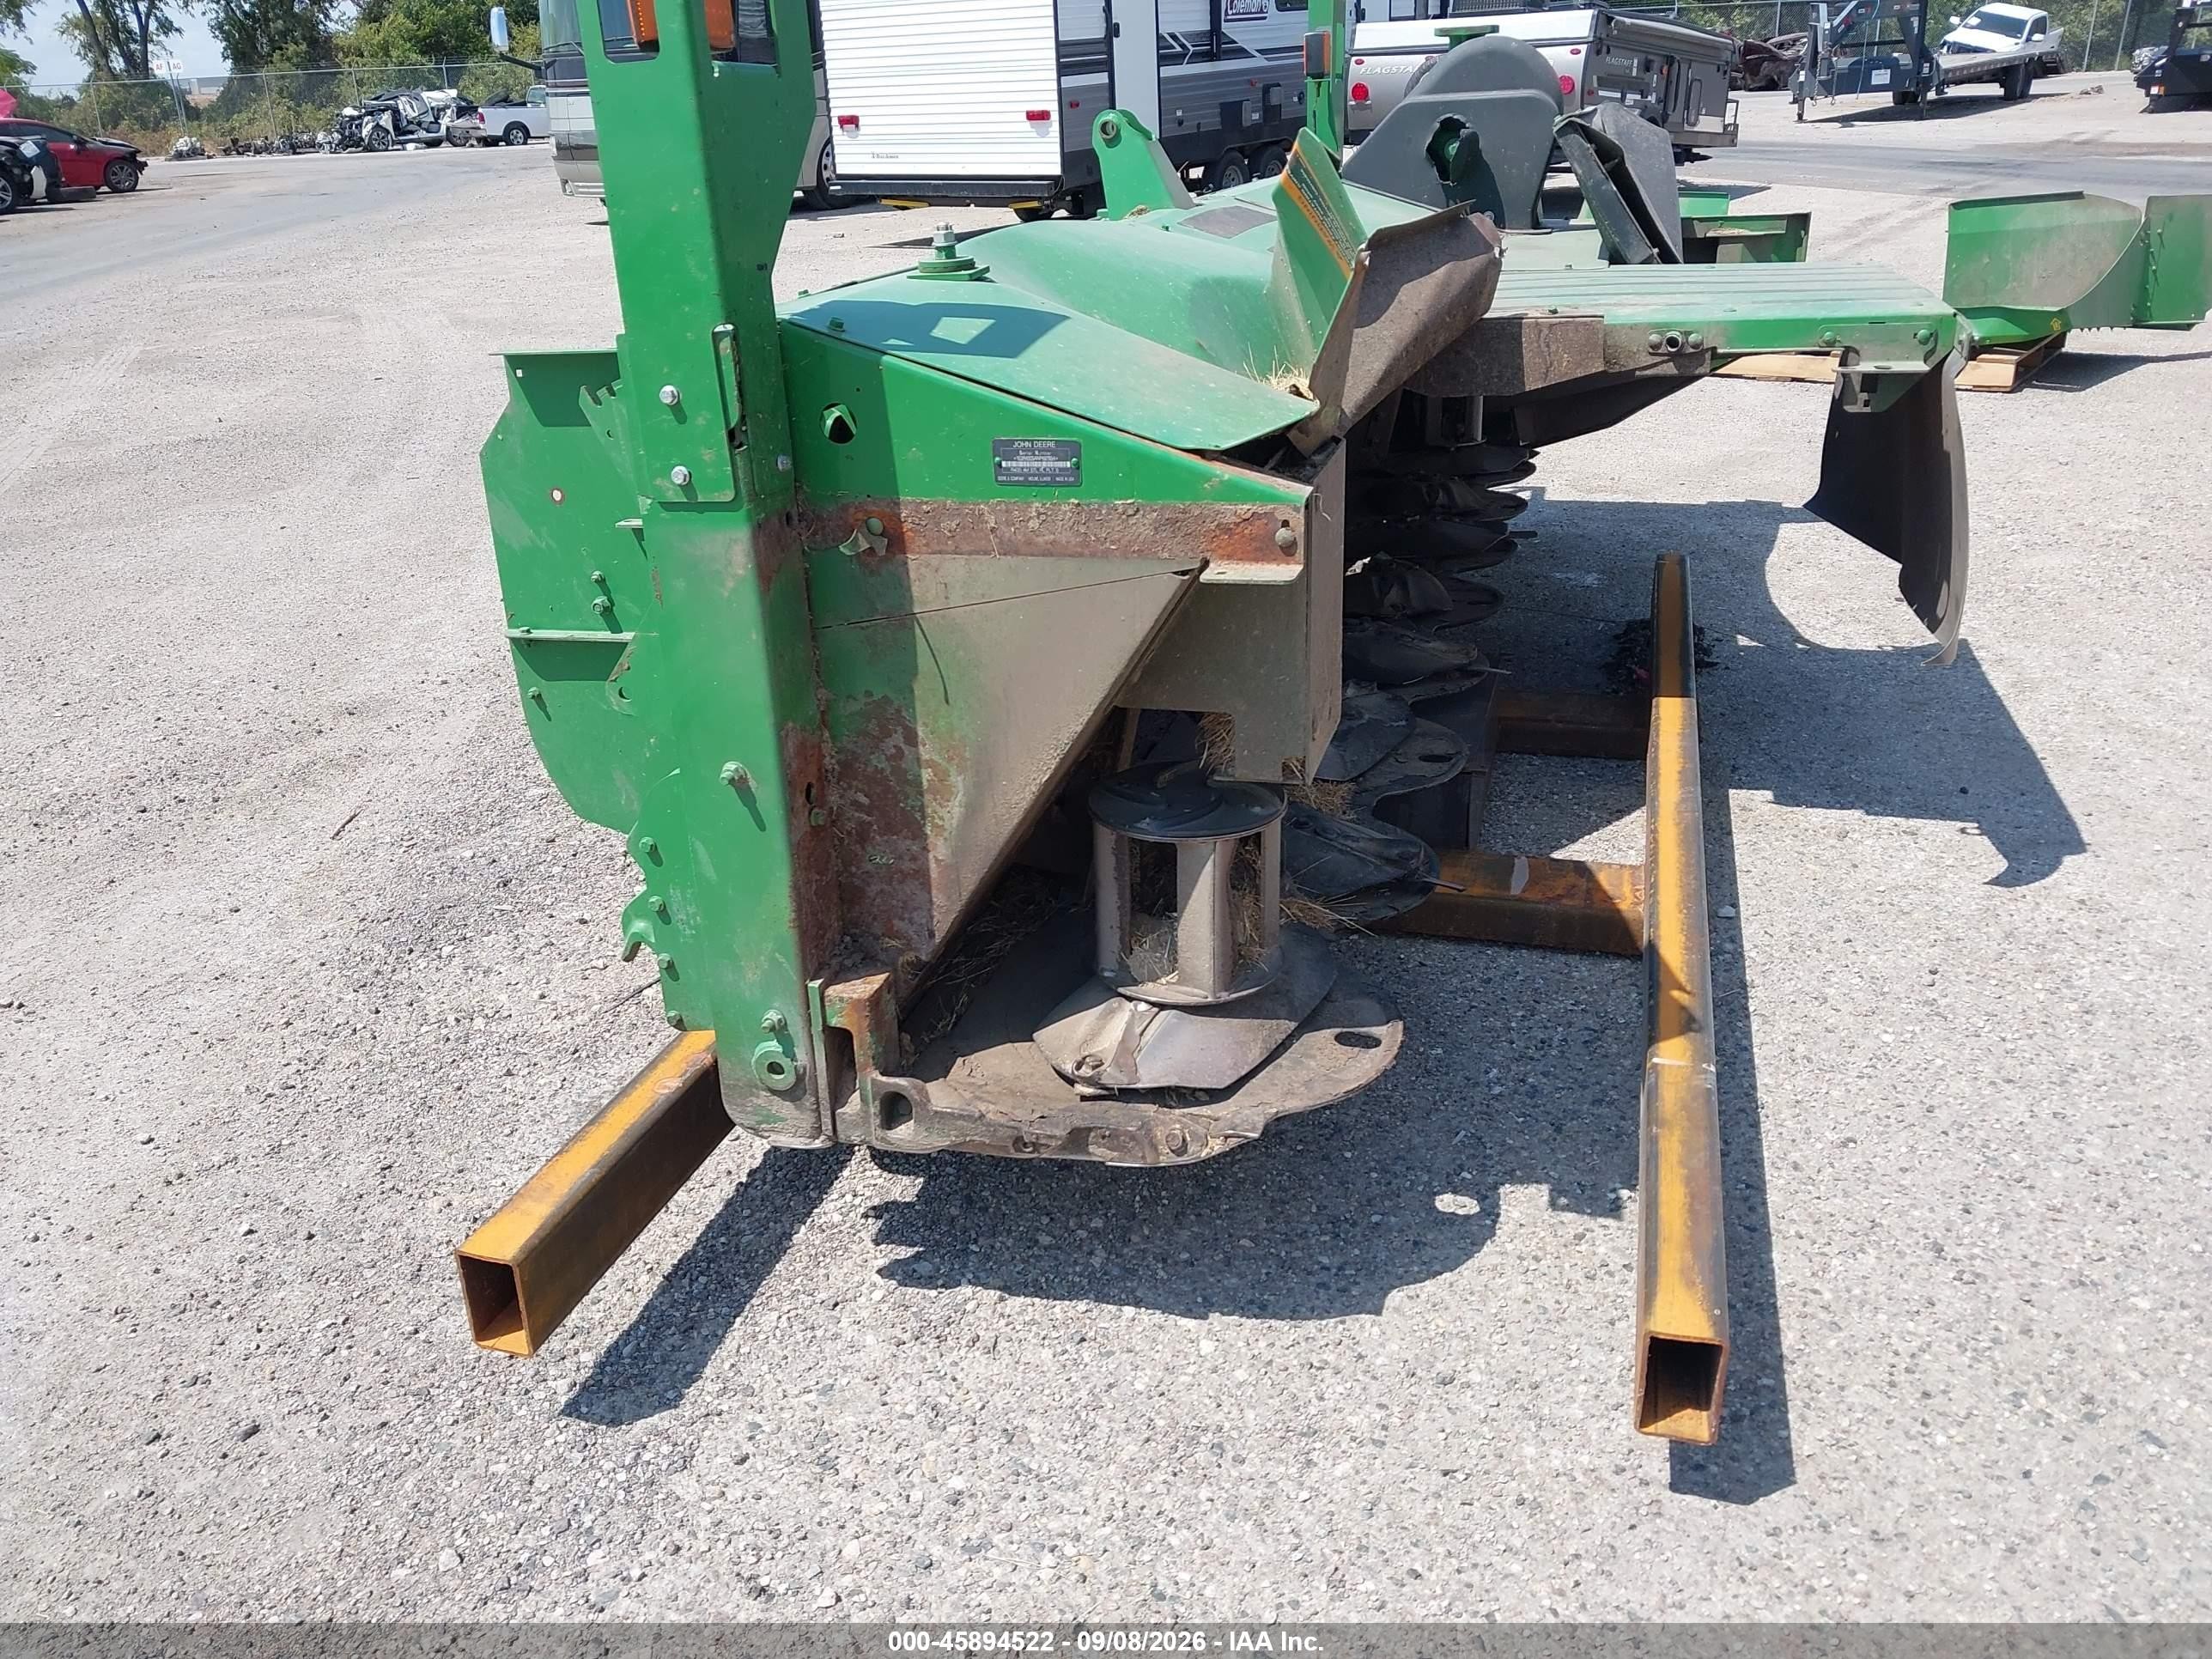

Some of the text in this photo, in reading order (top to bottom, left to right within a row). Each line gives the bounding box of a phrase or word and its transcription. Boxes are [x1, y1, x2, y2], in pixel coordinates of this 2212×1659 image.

[1227, 0, 1262, 15] Coleman
[1606, 56, 1633, 67] FLAGSTAFF
[1359, 65, 1417, 76] FLAGSTA
